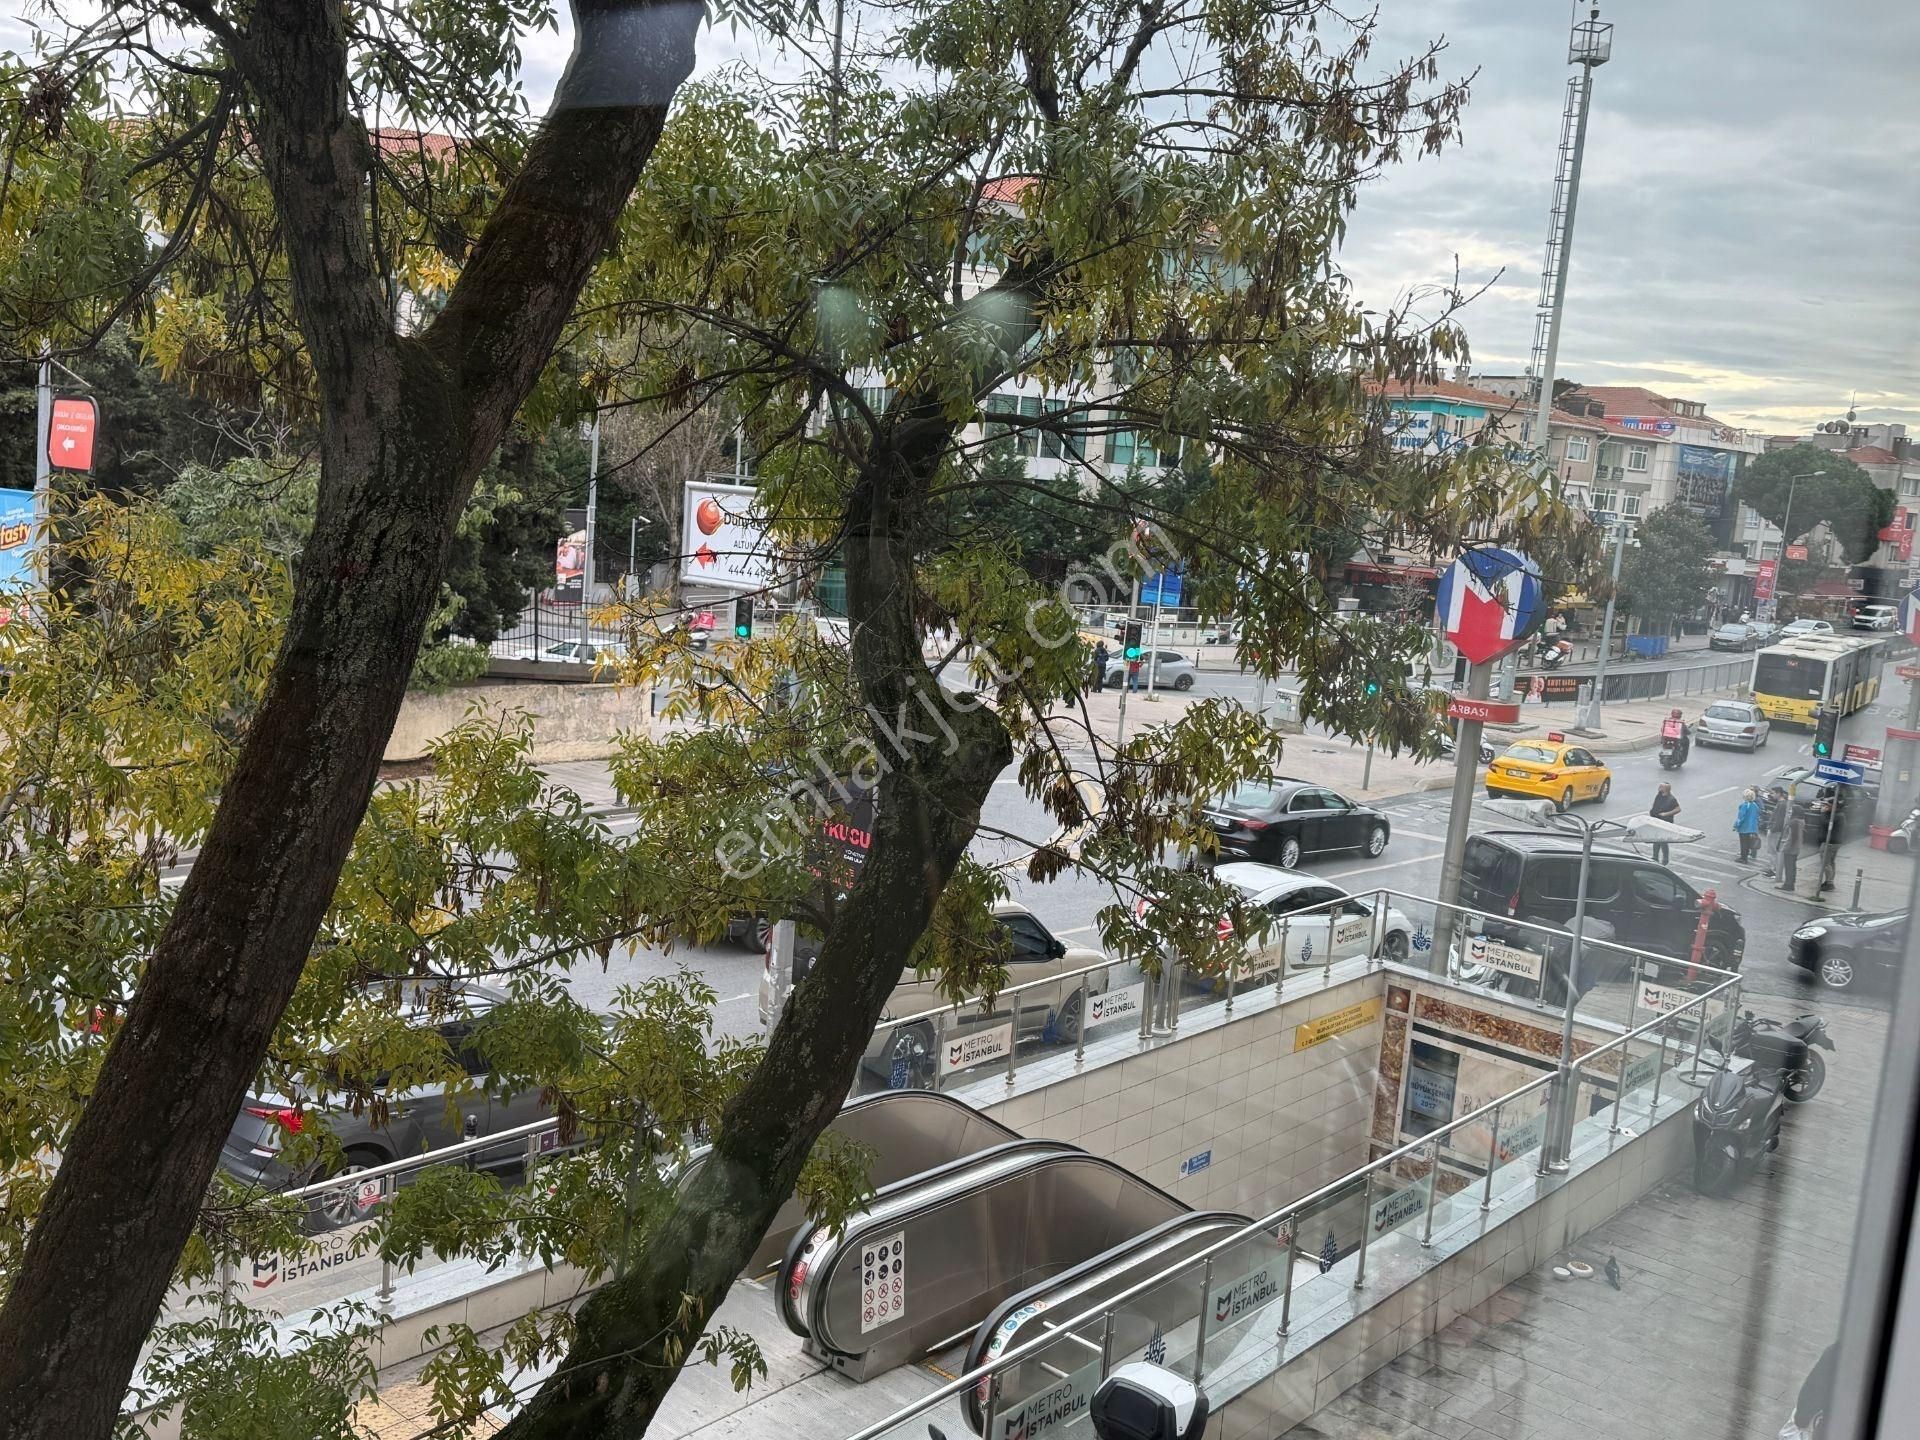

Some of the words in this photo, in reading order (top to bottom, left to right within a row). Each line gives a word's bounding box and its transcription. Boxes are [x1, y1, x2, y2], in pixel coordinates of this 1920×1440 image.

[734, 540, 774, 552] ALTUNZADE
[747, 567, 753, 577] 4
[1252, 950, 1271, 963] ETRO
[1487, 945, 1521, 961] METRO
[1486, 953, 1534, 975] İSTANBUL
[1104, 991, 1128, 1006] METRO
[1662, 991, 1700, 1007] METR
[1103, 1001, 1136, 1018] İSTANBUL
[963, 1034, 993, 1050] METRO
[963, 1043, 1003, 1063] İSTANBUL
[1388, 1189, 1415, 1209] METRO
[1386, 1200, 1423, 1228] İSTANBUL
[281, 1236, 344, 1267] MERO
[1233, 1270, 1267, 1299] METRO
[1231, 1281, 1278, 1317] İSTANBUL
[1027, 1383, 1073, 1419] METRO
[1025, 1393, 1087, 1440] İSTANBUL
